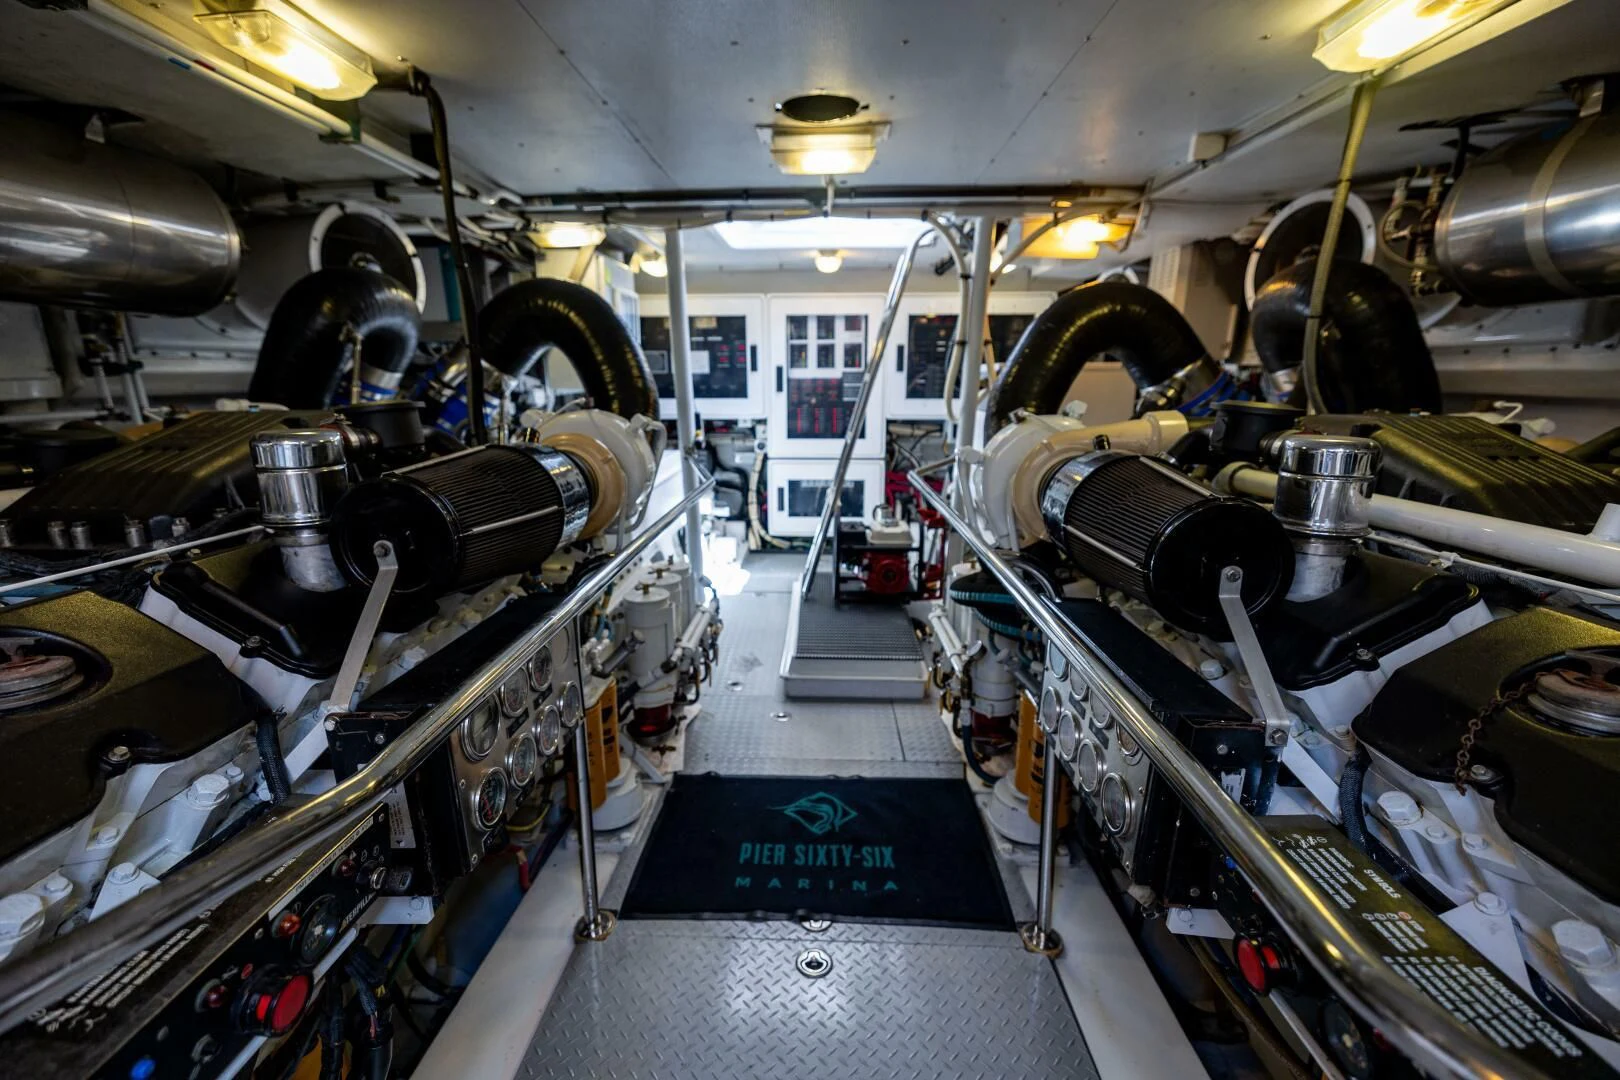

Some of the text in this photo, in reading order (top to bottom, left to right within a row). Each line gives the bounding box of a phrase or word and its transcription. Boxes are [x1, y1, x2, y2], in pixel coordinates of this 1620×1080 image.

[739, 843, 895, 869] PIER SIXTY-SIX
[735, 876, 899, 892] MARINA
[1472, 966, 1541, 1021] DIAGNOSTIC
